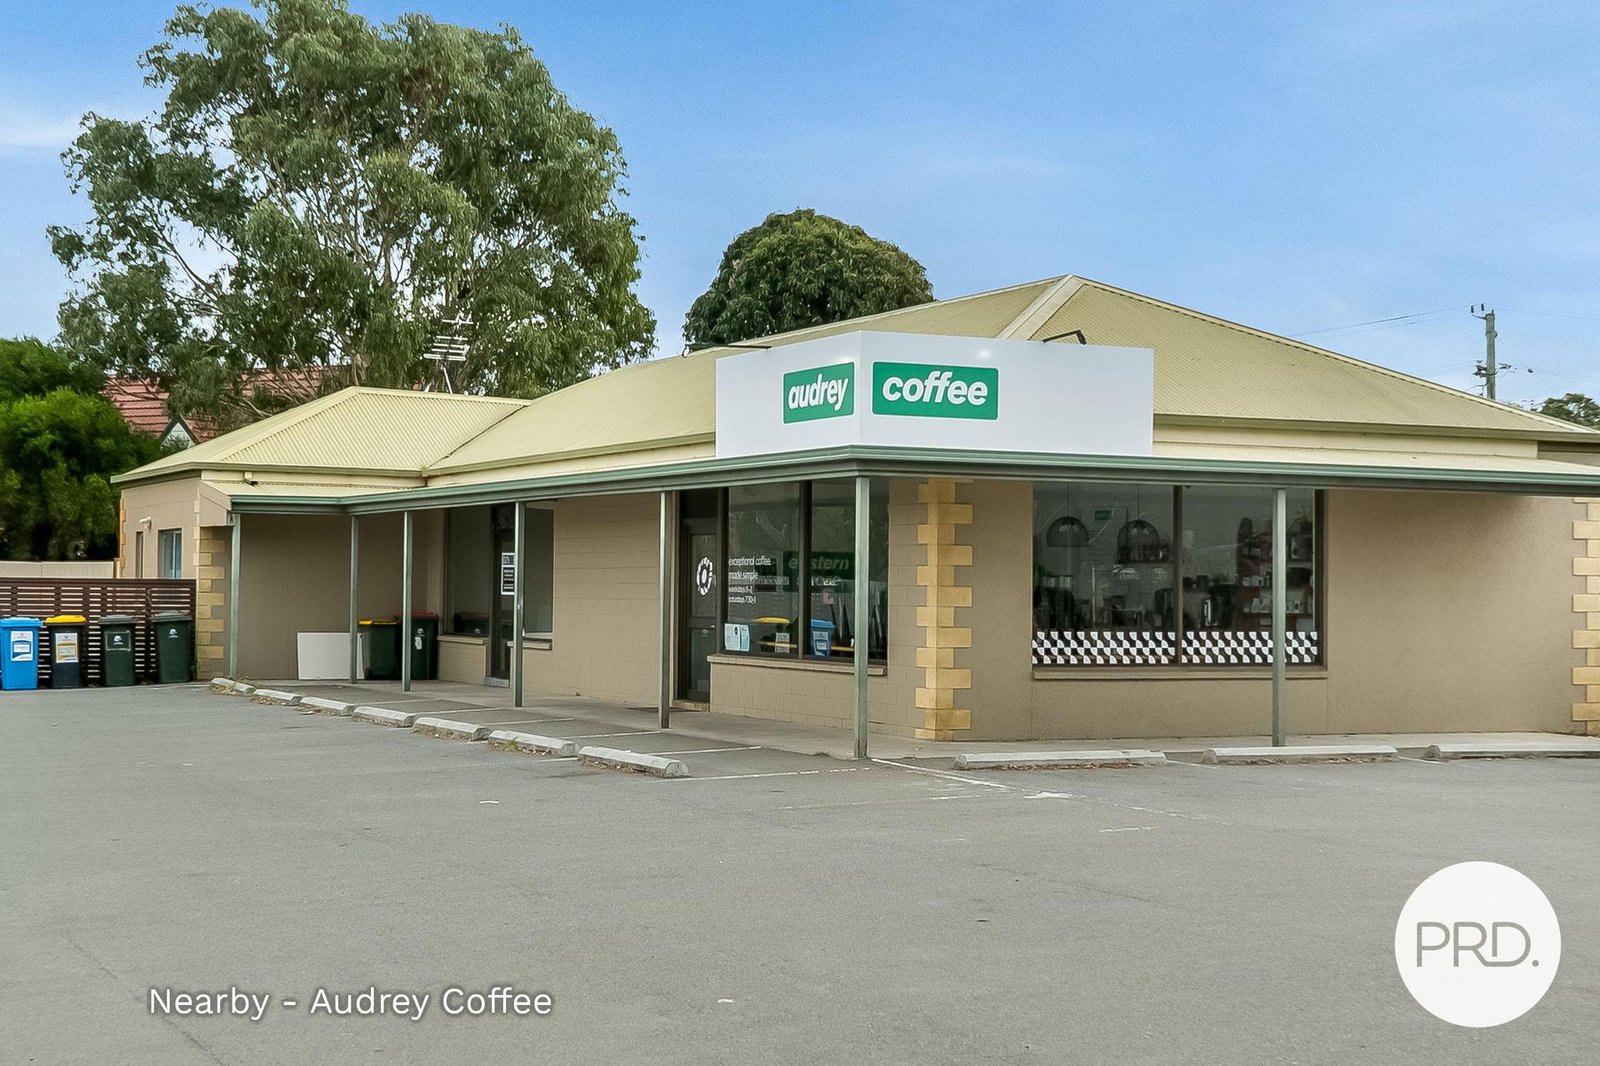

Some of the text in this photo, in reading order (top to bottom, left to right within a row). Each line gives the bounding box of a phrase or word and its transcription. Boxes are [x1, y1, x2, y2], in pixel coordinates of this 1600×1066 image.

[788, 373, 849, 411] audrey
[882, 370, 989, 406] coffee
[788, 555, 849, 570] estern
